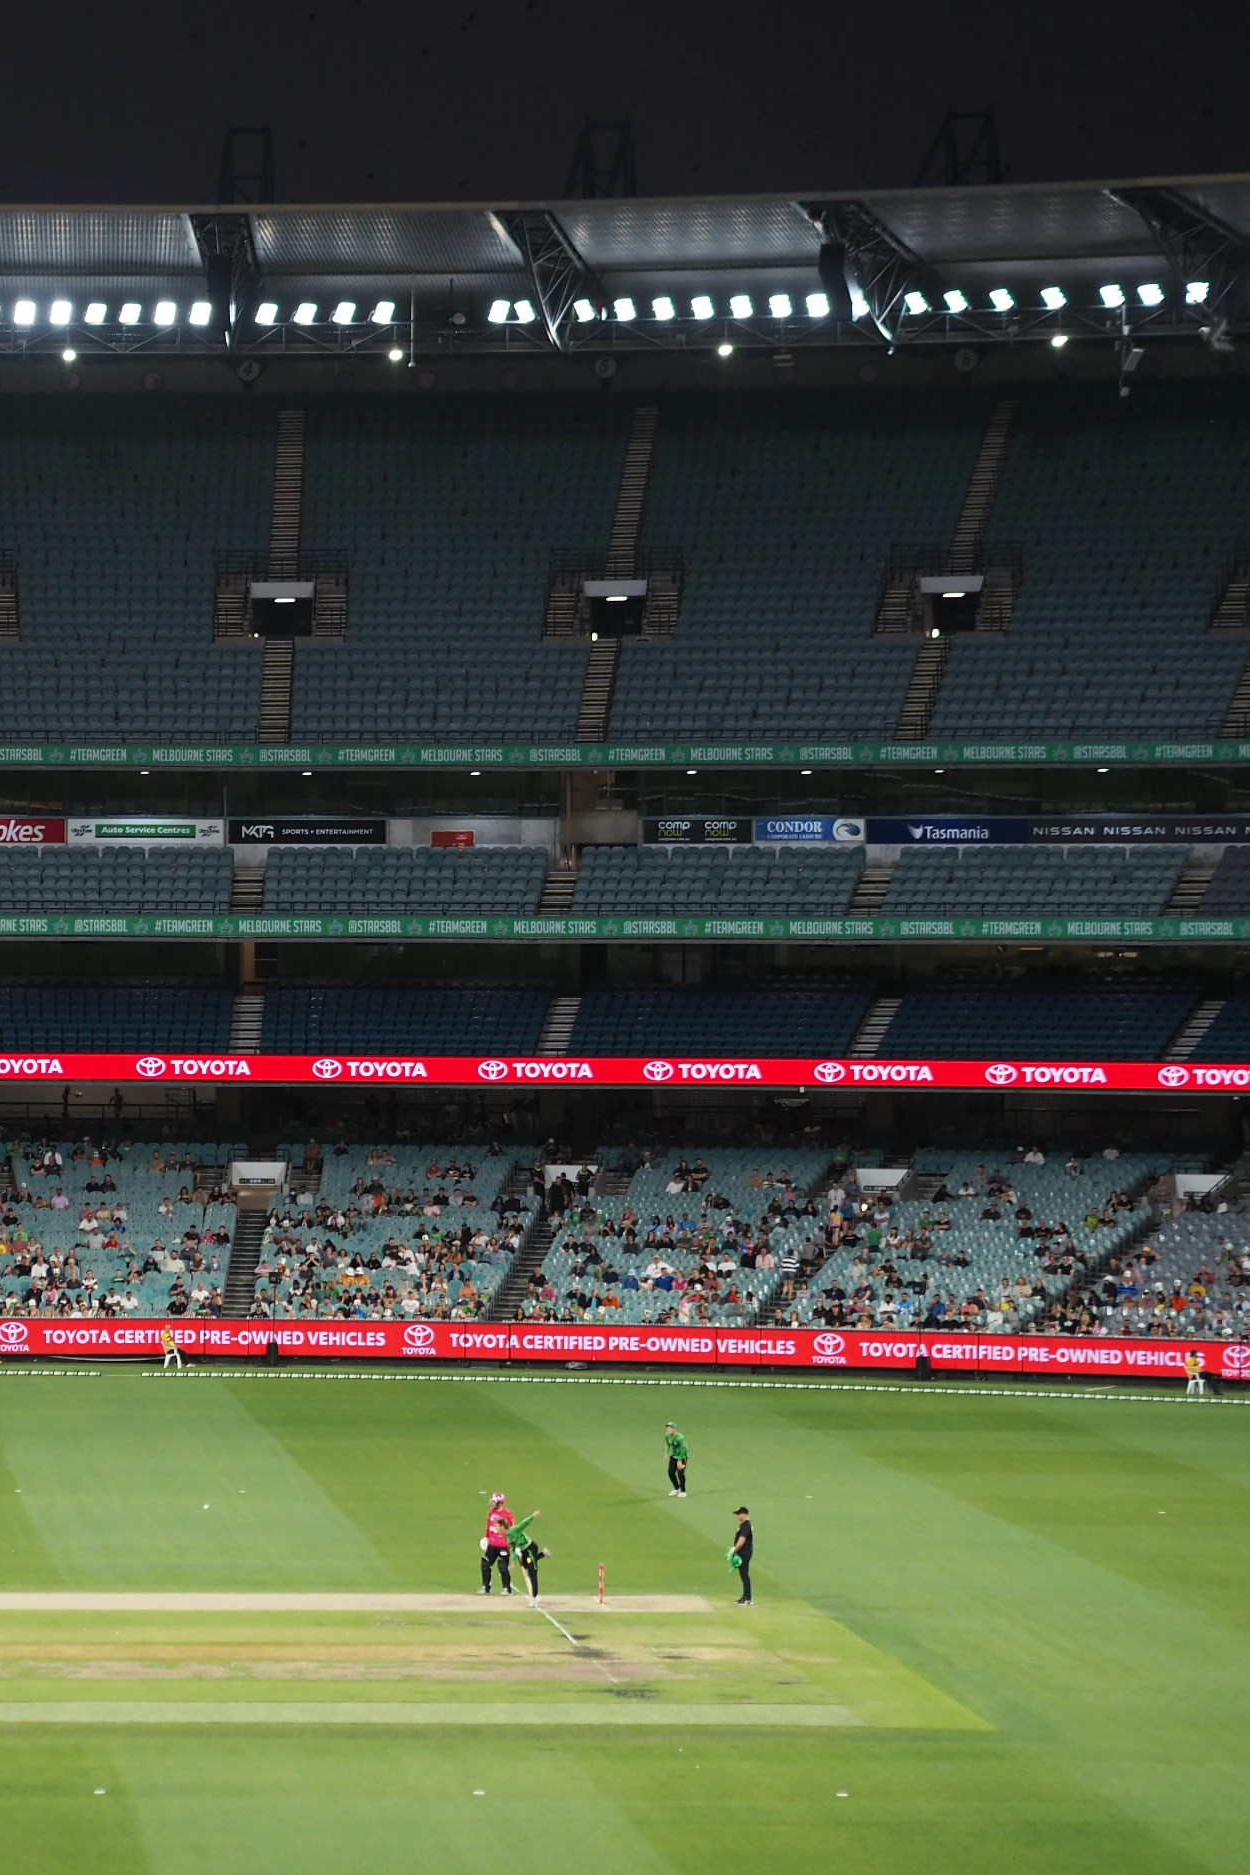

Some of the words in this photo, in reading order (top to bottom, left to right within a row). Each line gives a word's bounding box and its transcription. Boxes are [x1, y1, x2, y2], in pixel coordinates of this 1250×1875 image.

[69, 748, 127, 762] #TEAMGREEN
[152, 748, 203, 762] MELBOURNE
[205, 748, 233, 762] STARS
[259, 749, 312, 762] @STARSBBL
[337, 748, 396, 762] #TEAMGREEN
[420, 748, 472, 762] MELBOURNE
[475, 748, 503, 762] STARS
[529, 748, 582, 762] @STARSBBL
[608, 748, 666, 761] #TEAMGREEN
[690, 747, 742, 761] MELBOURNE
[745, 747, 773, 761] STARS
[799, 746, 854, 760] @STARSBBL
[879, 746, 937, 760] #TEAMGREEN
[963, 746, 1016, 760] MELBOURNE
[1018, 746, 1047, 760] STARS
[1074, 745, 1127, 759] @STARSBBL
[1155, 744, 1213, 758] #TEAMGREEN
[101, 826, 123, 834] Auto
[125, 826, 155, 834] Service
[157, 826, 190, 834] Centres
[658, 821, 690, 832] comp
[704, 821, 736, 832] comp
[766, 821, 823, 833] CONDOR
[1033, 827, 1095, 836] NISSAN
[1103, 827, 1166, 836] NISSAN
[1174, 827, 1237, 836] NISSAN
[658, 829, 682, 837] now
[704, 829, 728, 837] now
[924, 825, 989, 840] Tasmania
[19, 918, 48, 932] STARS
[74, 918, 128, 933] @STARSBBL
[154, 919, 214, 933] #TEAMGREEN
[238, 919, 291, 933] MELBOURNE
[293, 919, 322, 933] STARS
[348, 919, 403, 934] @STARSBBL
[428, 920, 488, 934] #TEAMGREEN
[513, 920, 566, 934] MELBOURNE
[568, 920, 597, 934] STARS
[623, 920, 678, 935] @STARSBBL
[704, 920, 764, 935] #TEAMGREEN
[789, 921, 842, 935] MELBOURNE
[845, 921, 874, 935] STARS
[900, 921, 955, 935] @STARSBBL
[981, 921, 1042, 935] #TEAMGREEN
[1067, 921, 1121, 936] MELBOURNE
[1124, 921, 1153, 936] STARS
[1179, 921, 1234, 936] @STARSBBL
[171, 1060, 250, 1075] TOYOTA
[347, 1062, 427, 1077] TOYOTA
[513, 1063, 592, 1078] TOYOTA
[678, 1064, 761, 1079] TOYOTA
[850, 1065, 933, 1081] TOYOTA
[1022, 1067, 1106, 1083] TOYOTA
[1193, 1069, 1250, 1085] TOYO
[42, 1330, 110, 1344] TOYOTA
[113, 1330, 196, 1344] CERTIIED
[200, 1330, 304, 1345] PRE-OWNED
[307, 1331, 386, 1346] VEHICLES
[450, 1334, 519, 1349] TOYOTA
[523, 1335, 605, 1350] CERTIFIED
[609, 1337, 712, 1352] PRE-OWNED
[716, 1339, 796, 1354] VEHICLES
[402, 1347, 437, 1355] TOYOTA
[859, 1342, 928, 1358] TOYOTA
[932, 1344, 1014, 1361] CERTIFIED
[1018, 1346, 1121, 1364] PRE-OWNED
[1124, 1350, 1205, 1367] VEHICLS
[812, 1356, 846, 1365] TOYOTA
